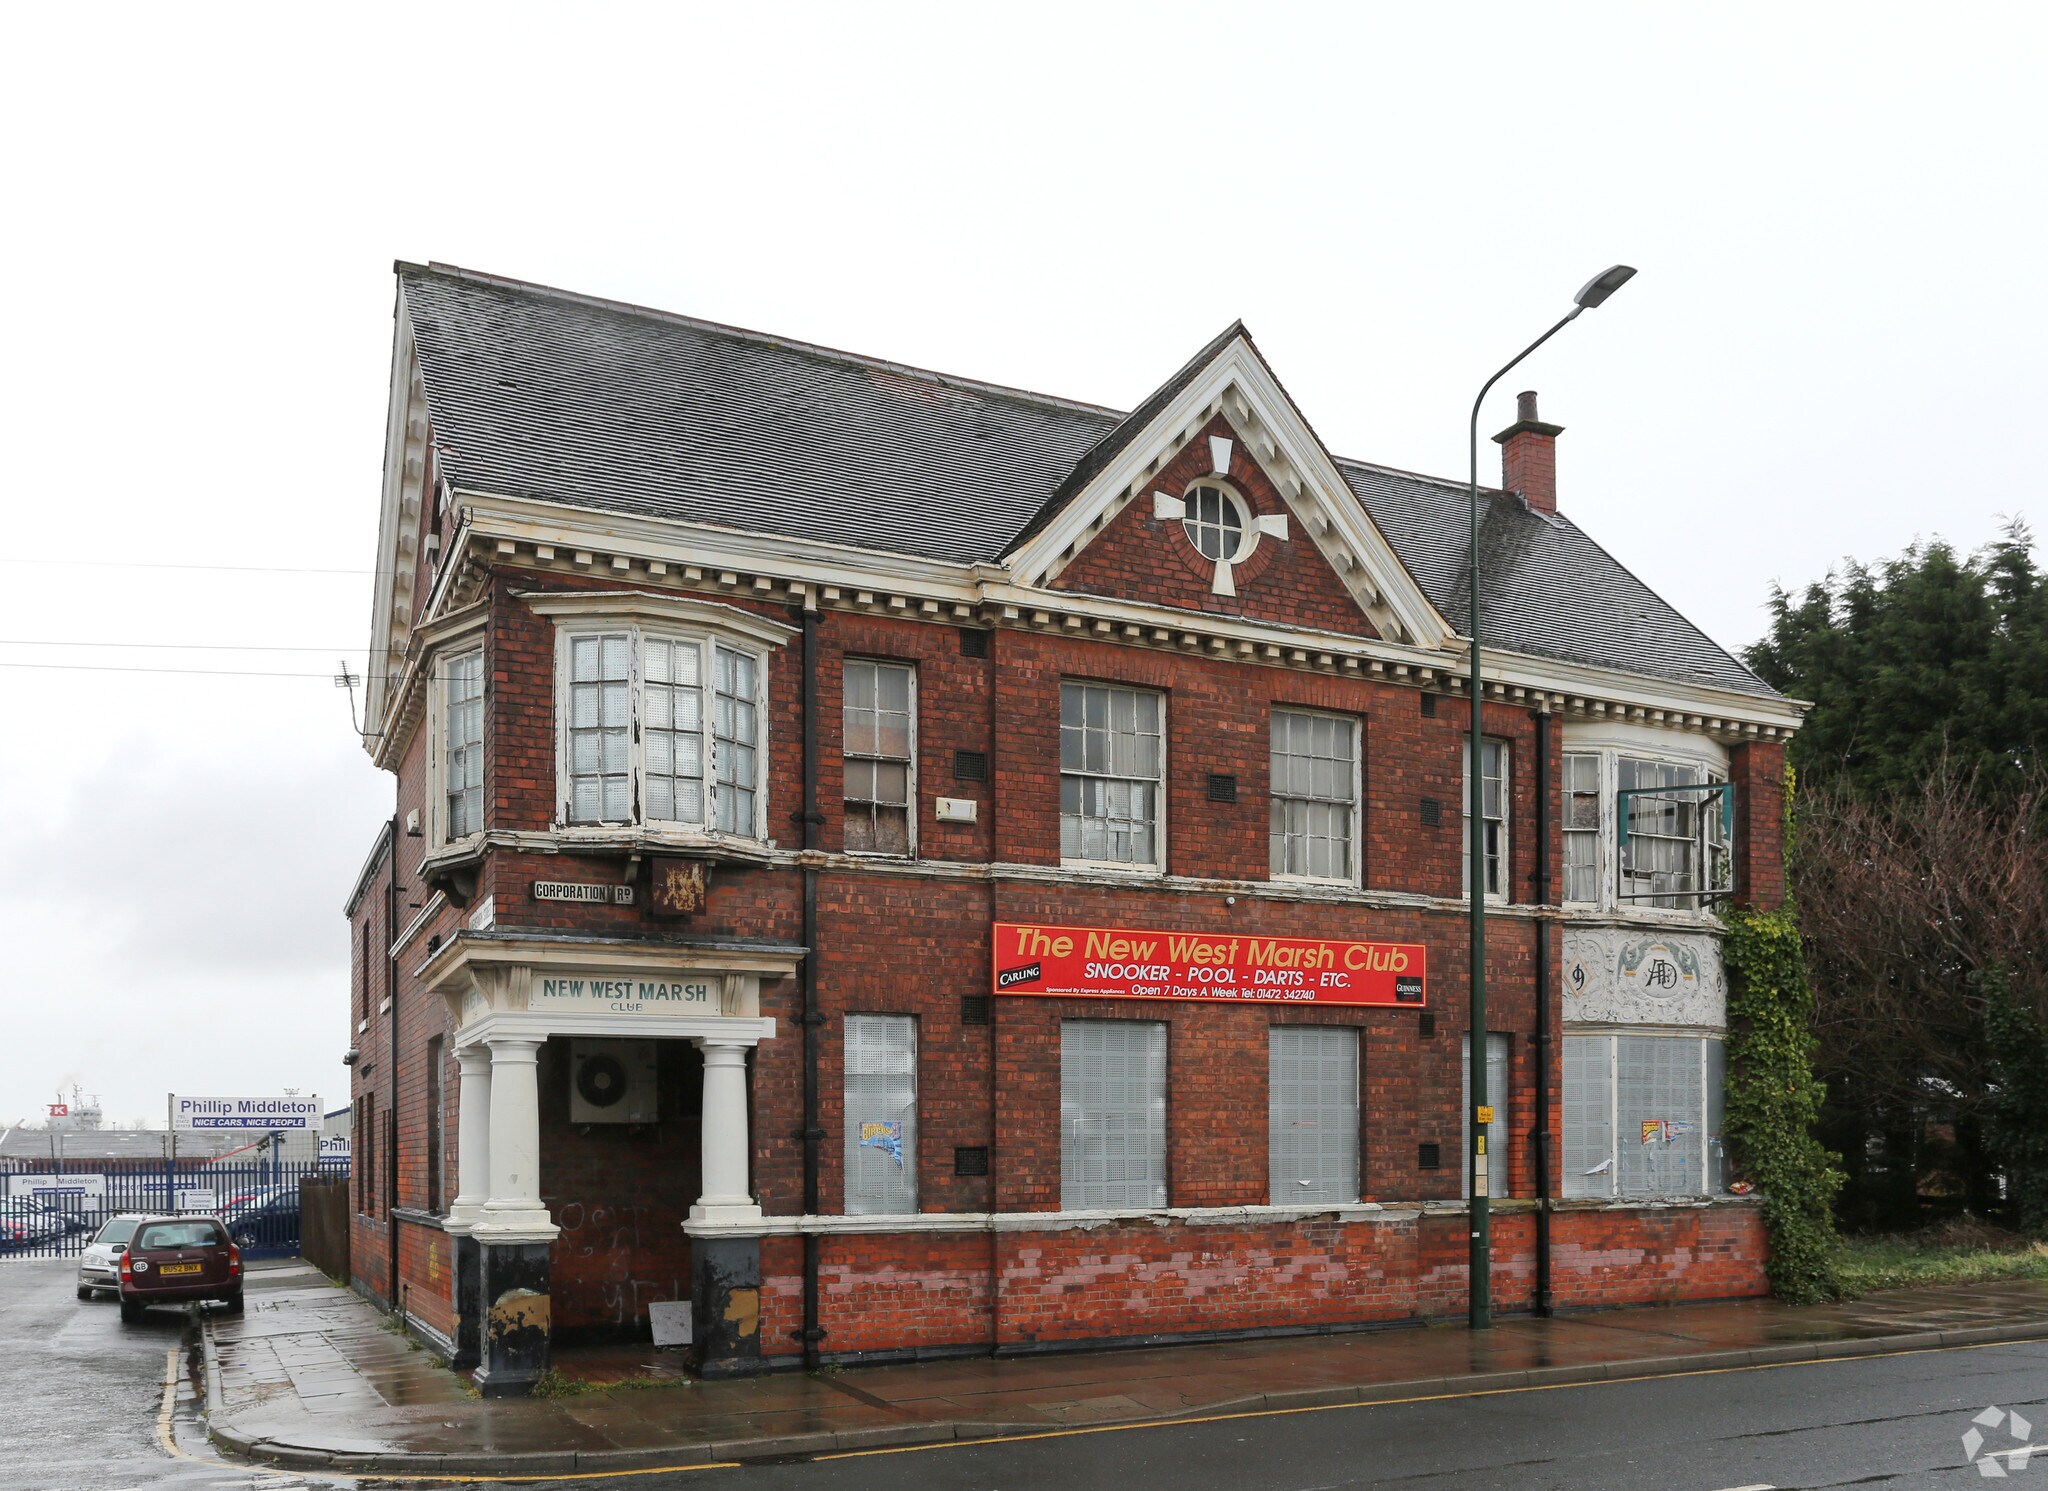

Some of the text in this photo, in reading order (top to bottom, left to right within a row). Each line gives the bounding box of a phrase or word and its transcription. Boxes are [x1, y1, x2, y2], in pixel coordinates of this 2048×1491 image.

[536, 883, 606, 900] CORPORATION
[1016, 928, 1409, 972] The New West Marsh Club
[999, 966, 1040, 986] CARLING
[1084, 962, 1171, 981] SNOOKER
[1188, 967, 1236, 984] POOL
[1254, 970, 1304, 986] DARTS
[1320, 972, 1351, 988] ETC.
[543, 979, 707, 1002] NEW WEST MARSH
[1131, 984, 1315, 1000] Open 7 Days A Week Tel: 01472 342740
[1396, 983, 1422, 993] GUINNESS
[610, 1002, 643, 1012] CLUB
[181, 1100, 316, 1115] Phillip Middleton
[193, 1119, 216, 1127] NICE
[217, 1119, 244, 1127] CARS,
[246, 1119, 268, 1127] NICE
[269, 1119, 304, 1127] PEOPLE
[862, 1127, 891, 1141] CIRCUS
[134, 1262, 147, 1271] GB
